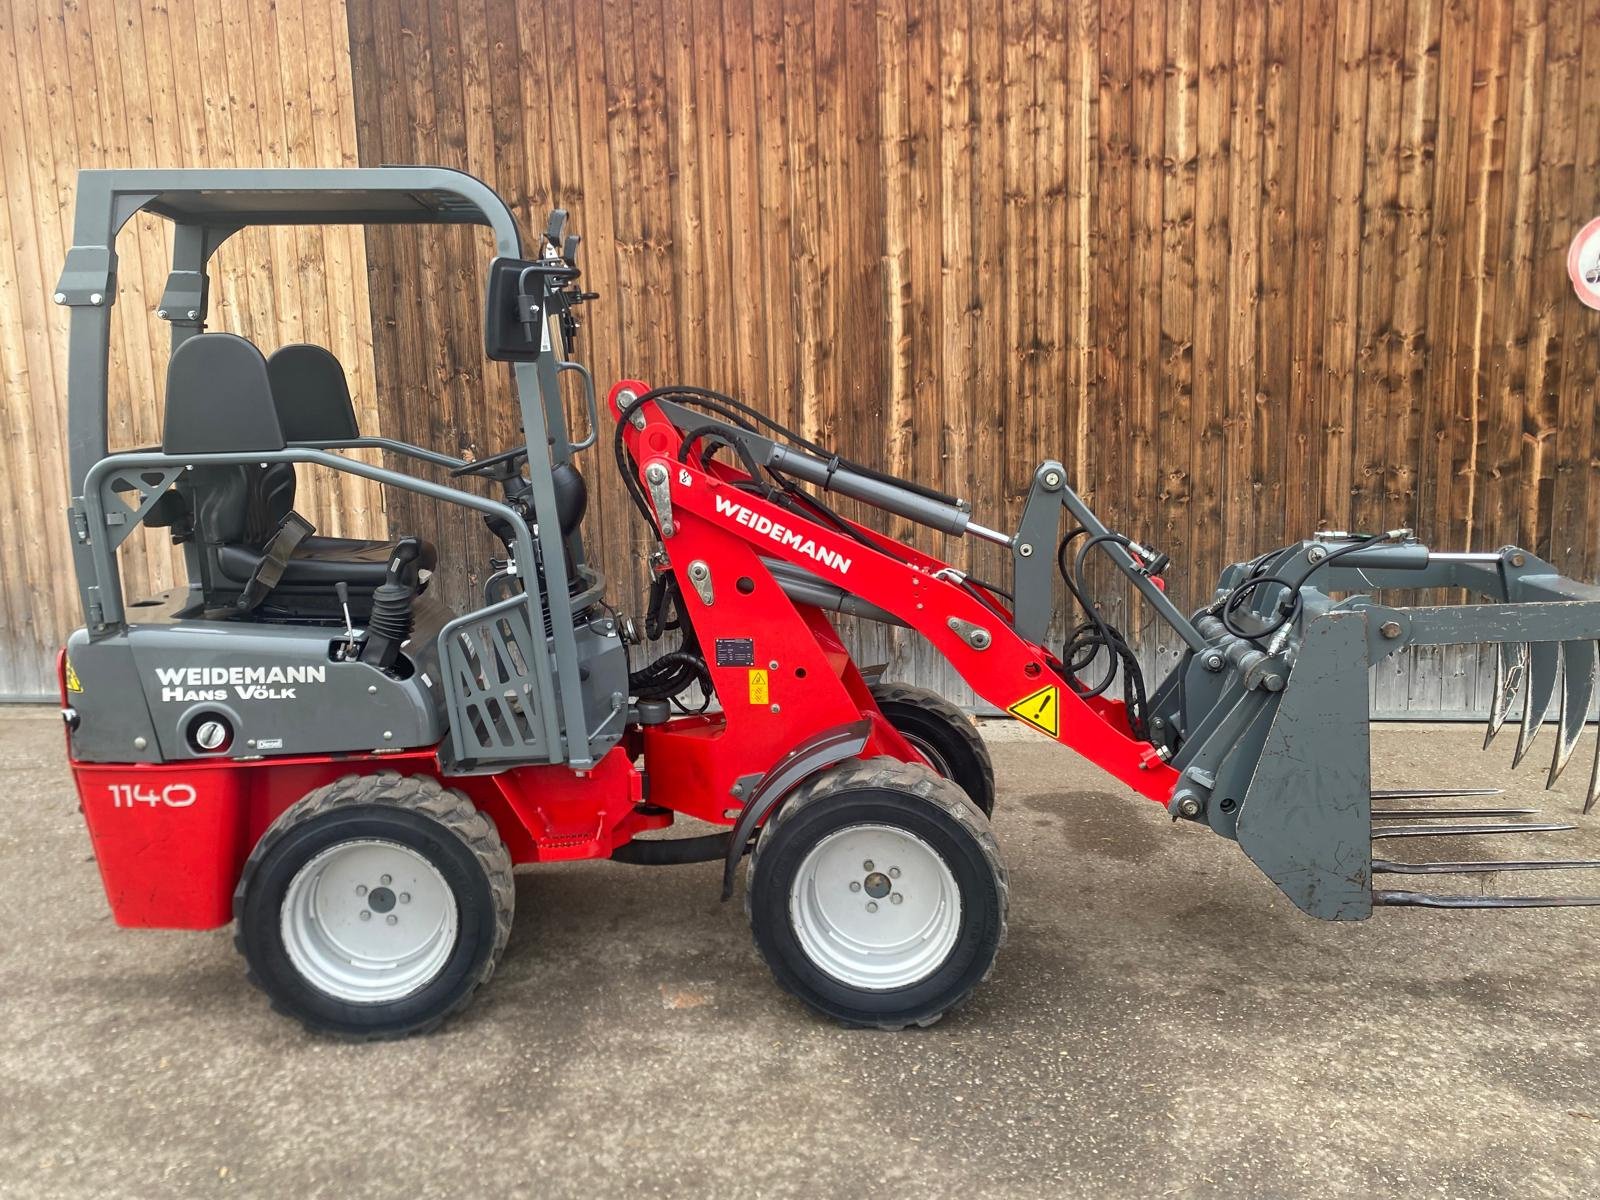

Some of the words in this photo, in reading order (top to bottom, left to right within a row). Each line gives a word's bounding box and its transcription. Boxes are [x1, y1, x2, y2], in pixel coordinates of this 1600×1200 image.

[715, 495, 852, 574] WEIDEMANN
[155, 666, 326, 685] WEIDEMANN
[108, 784, 197, 807] 1140
